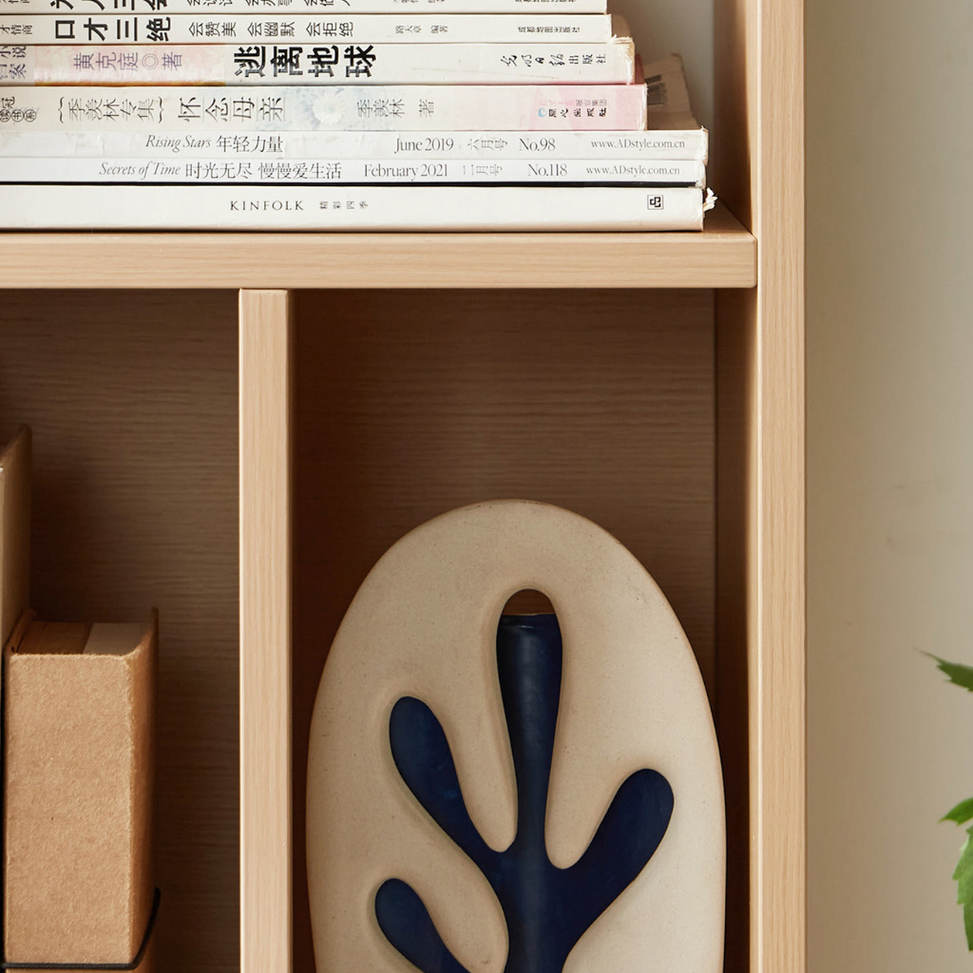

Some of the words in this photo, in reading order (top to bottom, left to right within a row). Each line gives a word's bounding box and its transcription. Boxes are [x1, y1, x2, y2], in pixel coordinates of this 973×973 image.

[55, 17, 171, 42] 口才三绝
[188, 21, 237, 37] 会赞美
[247, 21, 295, 37] 会幽默
[306, 21, 354, 37] 会拒绝
[234, 45, 377, 78] 逃离地球
[177, 96, 285, 123] 怀念母亲
[357, 98, 406, 118] 季羡林
[418, 99, 435, 118] 著
[145, 135, 181, 153] Rising
[182, 135, 211, 149] Stars
[216, 135, 283, 153] 年轻力量
[394, 138, 423, 154] June
[424, 138, 454, 151] 2019
[467, 137, 508, 152] 六月号
[519, 138, 556, 151] No.98
[591, 138, 685, 152] www.ADstyle.com.cn
[99, 162, 136, 176] Secrets
[138, 161, 153, 180] of
[153, 162, 181, 176] Time
[185, 162, 253, 180] 时光无尽
[258, 162, 342, 180] 慢慢爱生活
[363, 164, 418, 181] February
[420, 164, 449, 177] 2021
[528, 164, 568, 177] No.118
[586, 164, 680, 179] www.ADstyle.com.cn
[230, 201, 304, 211] KINFOLK
